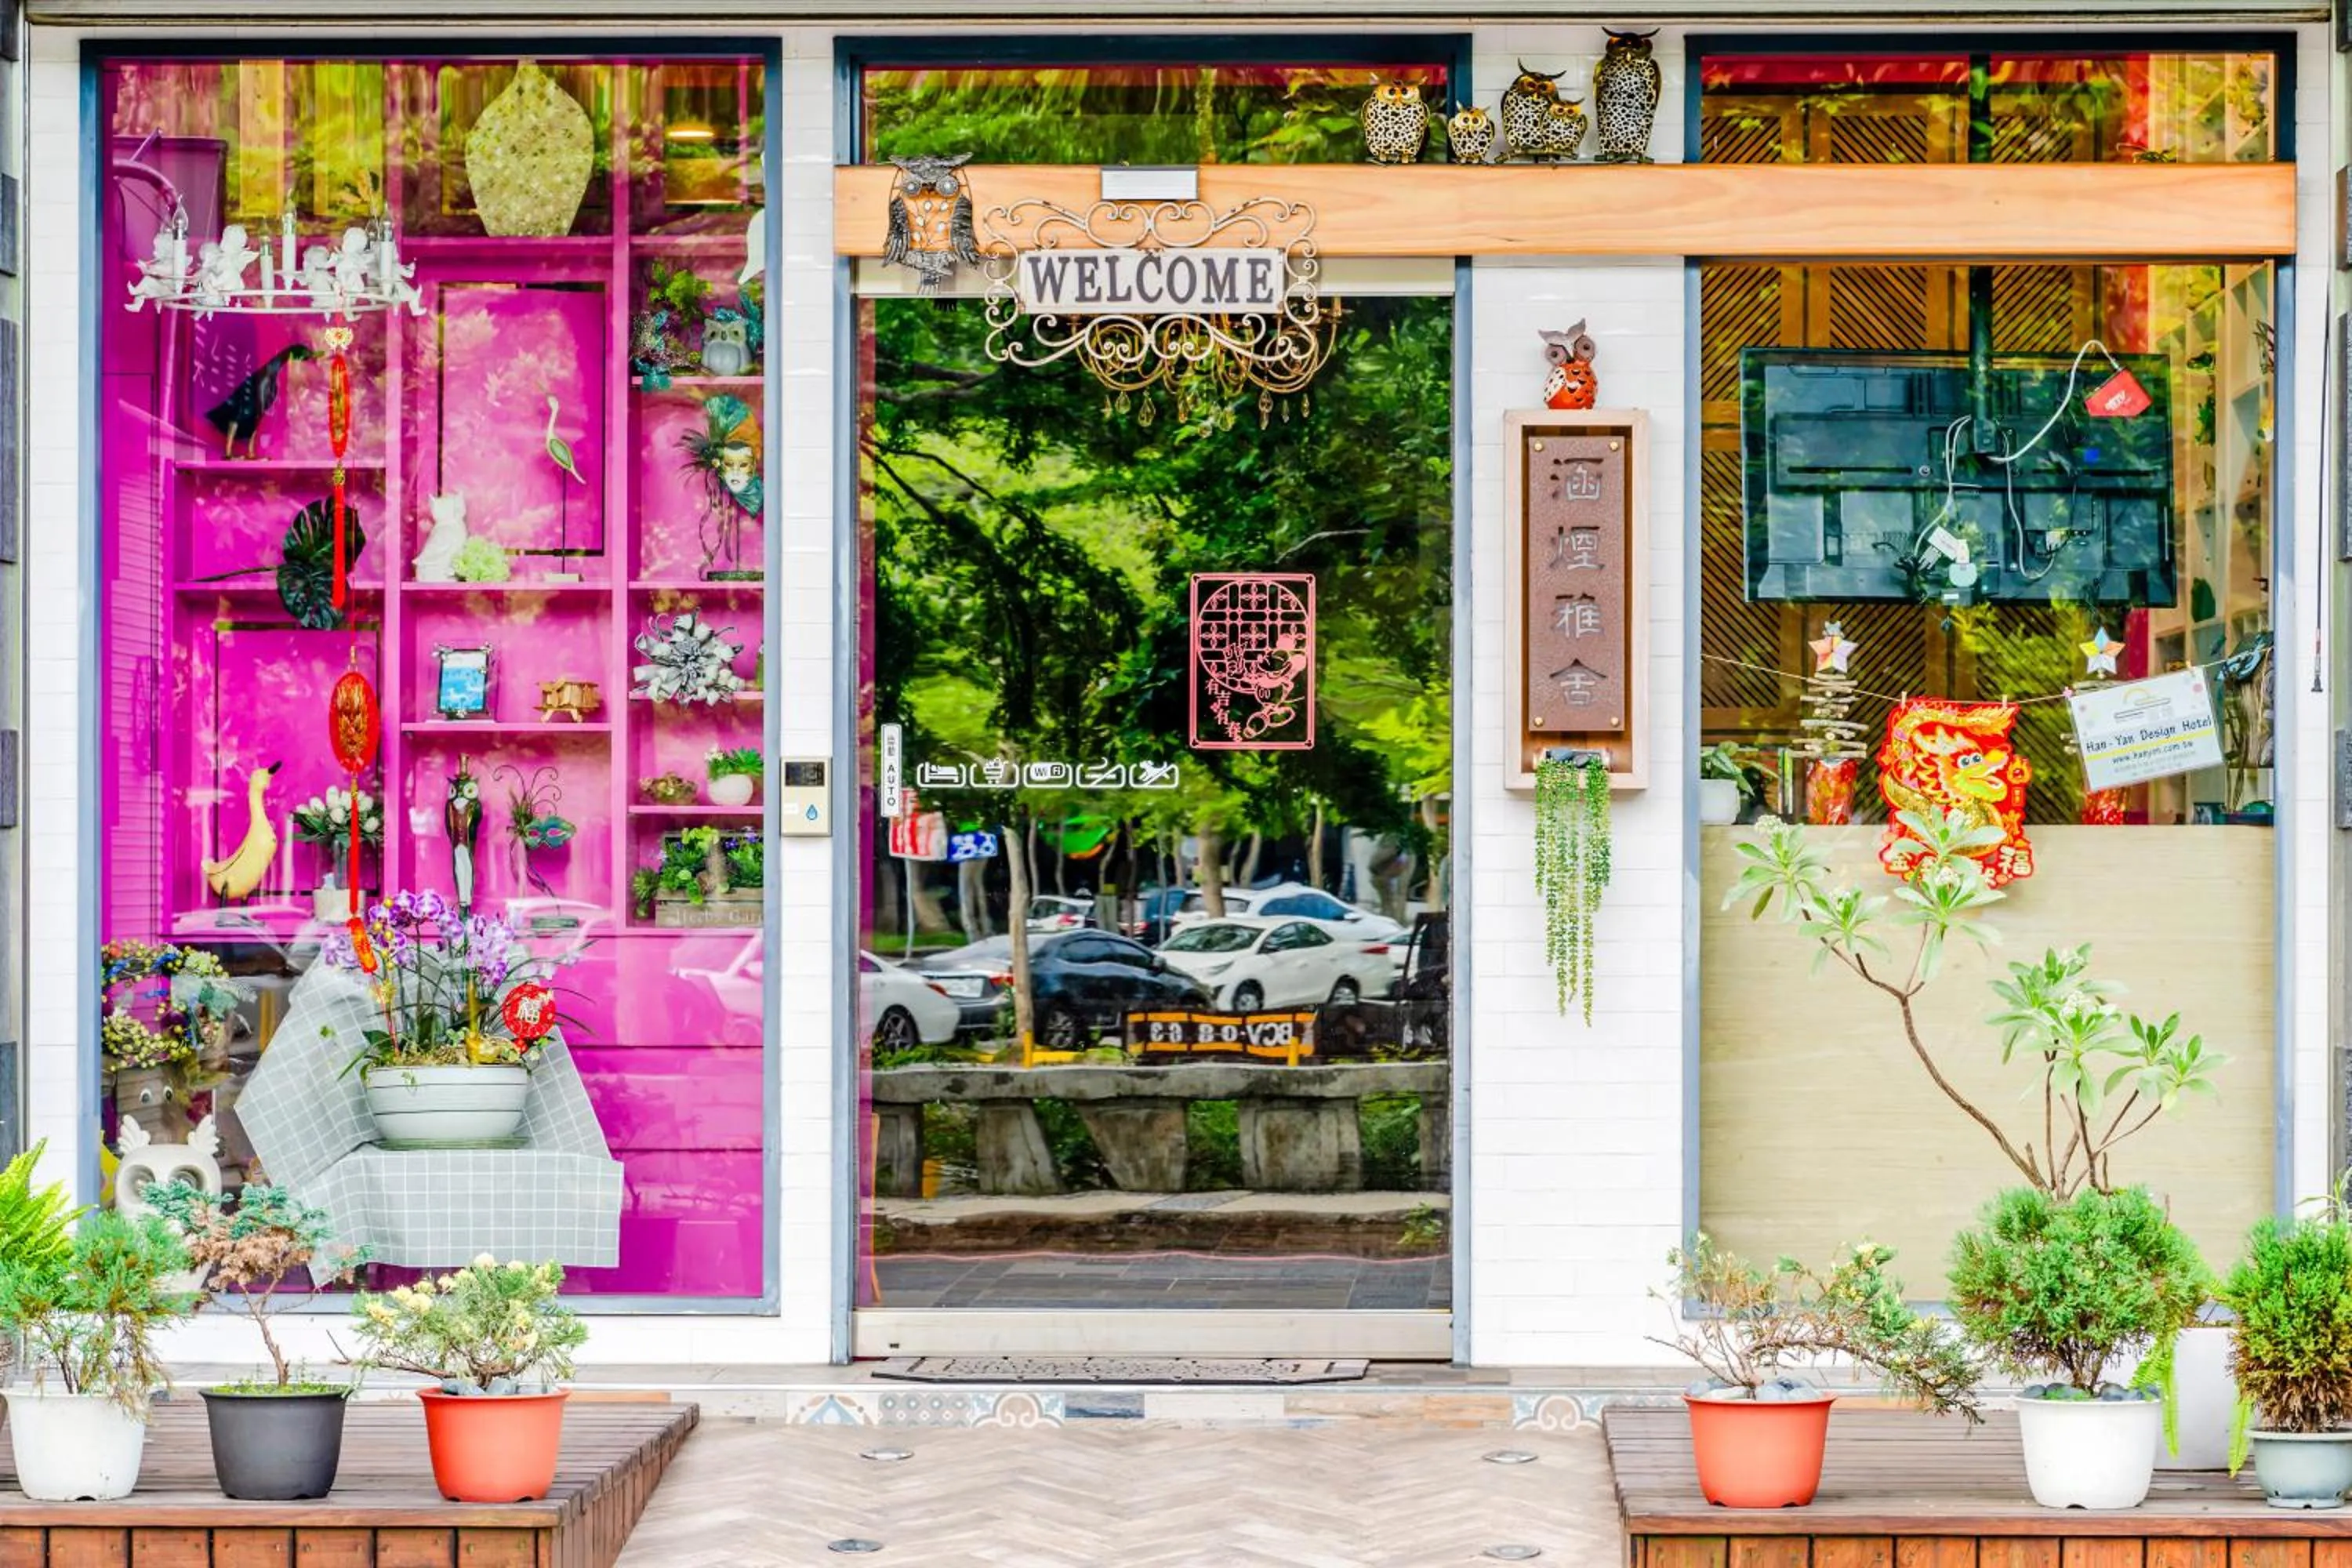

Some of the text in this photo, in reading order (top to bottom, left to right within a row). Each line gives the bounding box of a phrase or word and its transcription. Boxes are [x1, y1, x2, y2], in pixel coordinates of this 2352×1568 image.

[1027, 254, 1274, 304] WELCOME
[2140, 724, 2176, 741] Design
[2182, 715, 2212, 731] Hotel
[887, 764, 896, 807] AUTO
